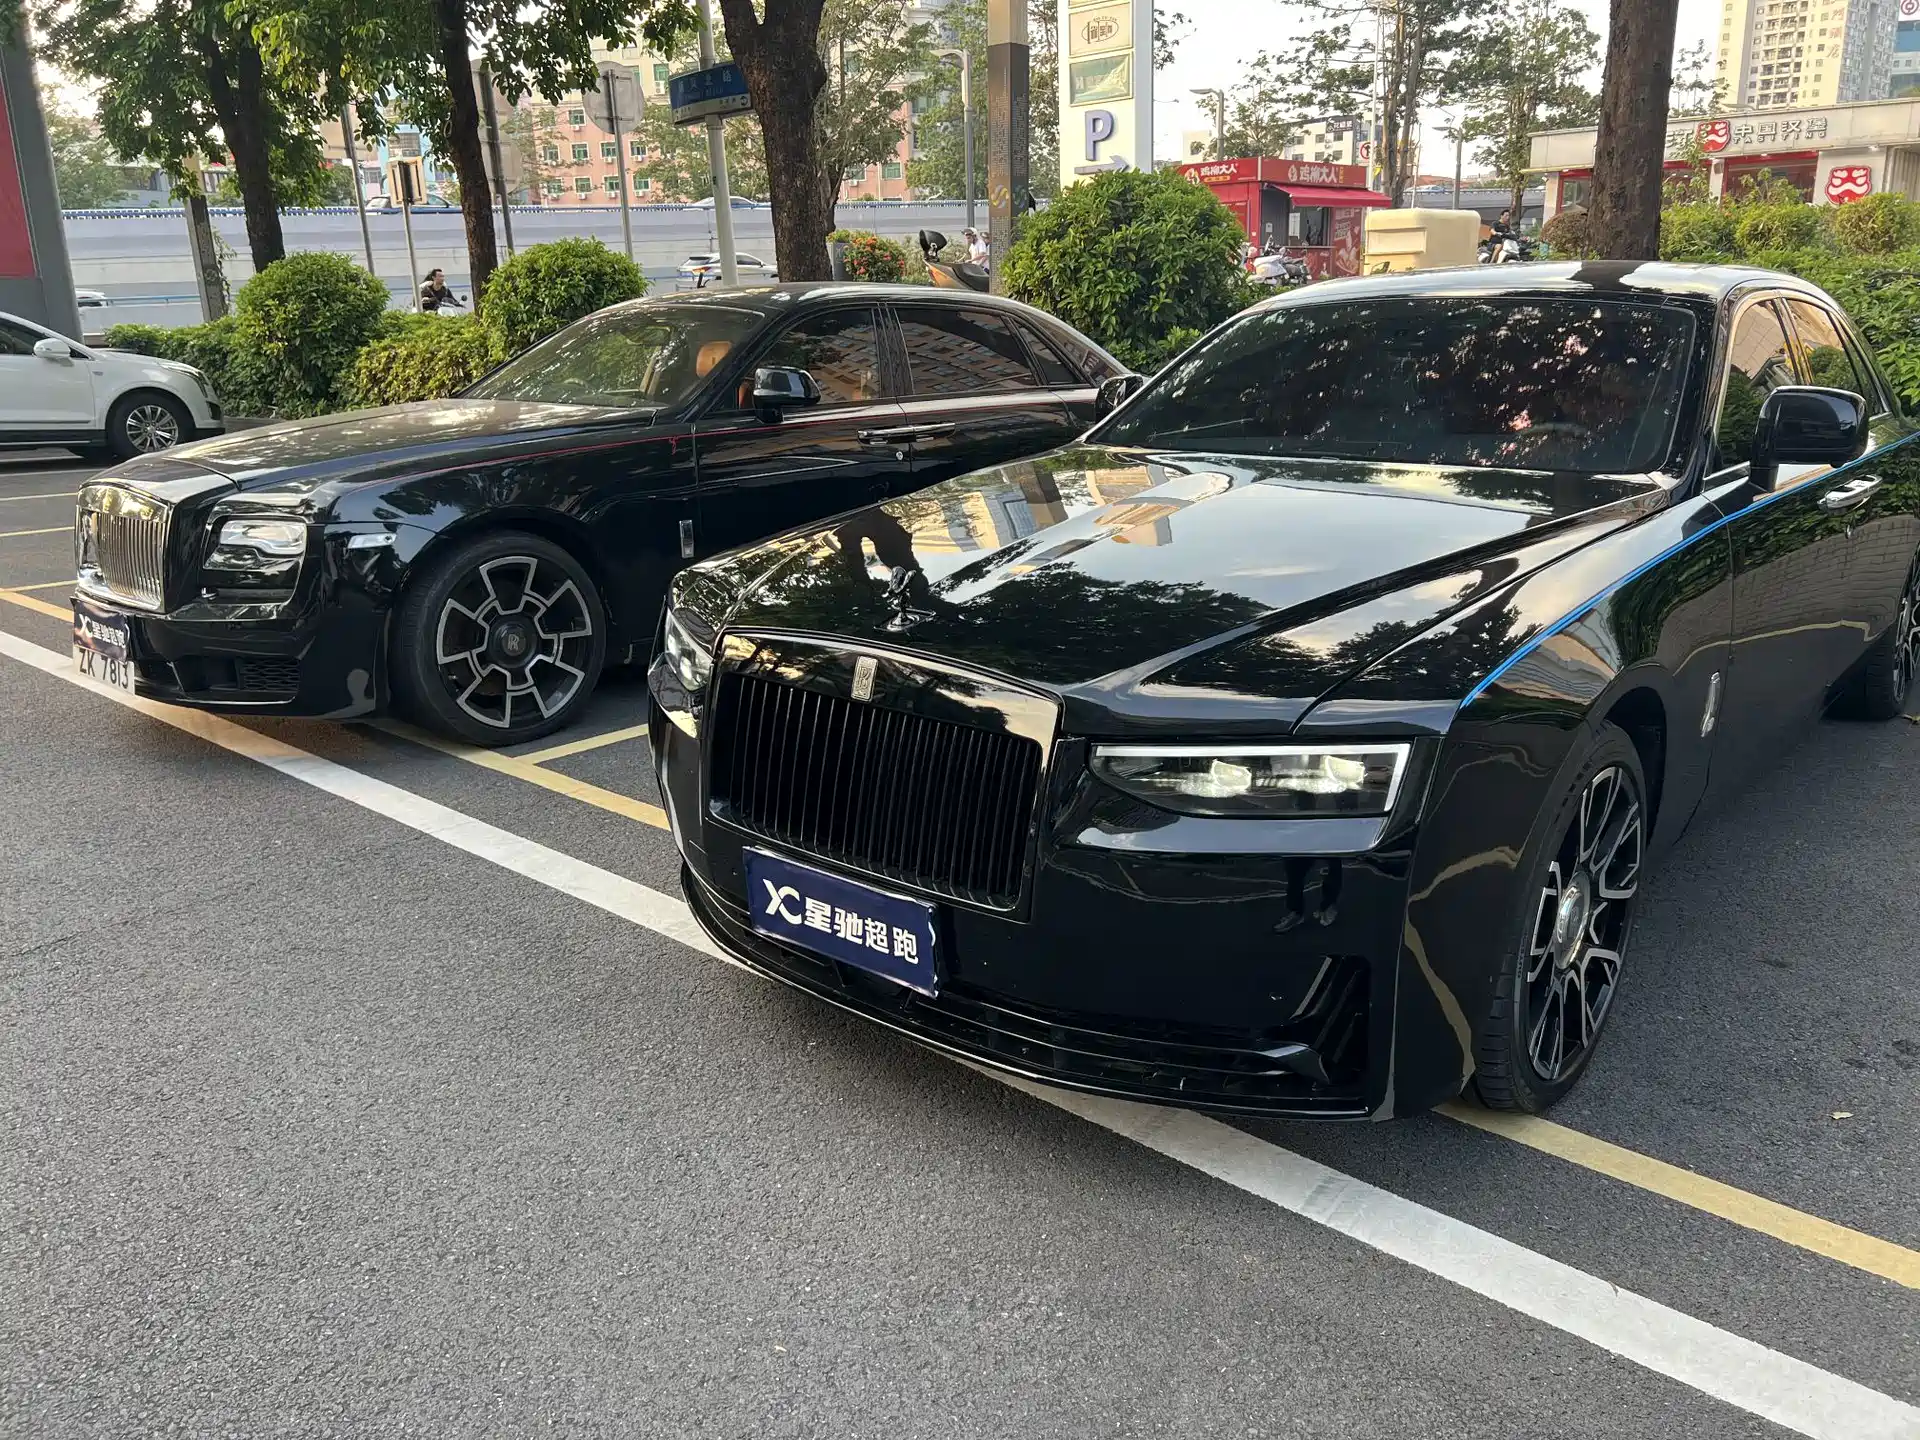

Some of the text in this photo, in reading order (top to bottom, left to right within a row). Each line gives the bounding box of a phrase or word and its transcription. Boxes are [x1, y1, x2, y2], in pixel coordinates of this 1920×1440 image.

[1085, 109, 1115, 161] P
[1733, 131, 1828, 145] TASITING
[1734, 117, 1828, 138] 中国汉堡
[803, 896, 919, 965] 星驰超跑
